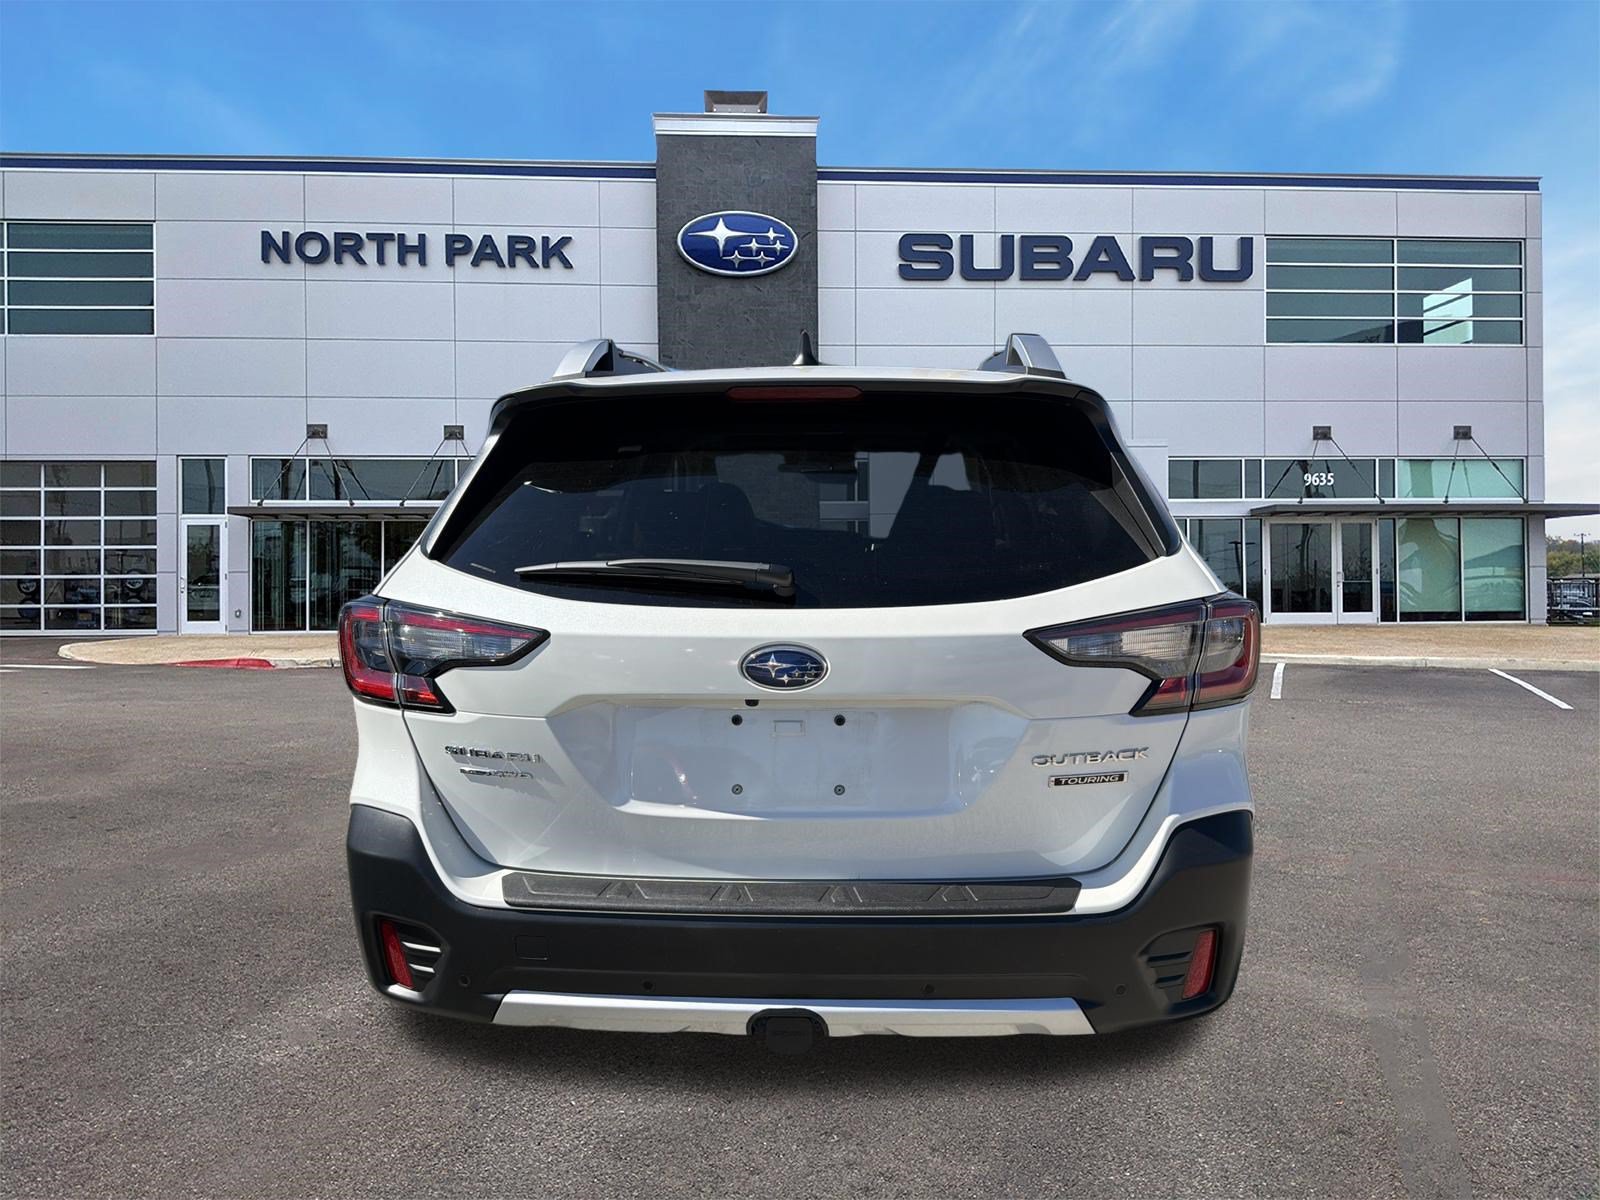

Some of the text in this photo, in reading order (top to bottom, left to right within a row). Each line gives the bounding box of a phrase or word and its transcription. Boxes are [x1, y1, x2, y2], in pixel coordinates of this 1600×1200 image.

[261, 230, 574, 269] NORTH PARK
[898, 233, 1254, 282] SUBARU
[1303, 472, 1335, 486] 9635
[1031, 746, 1150, 768] OUTBACK
[1058, 774, 1120, 786] TOURING
